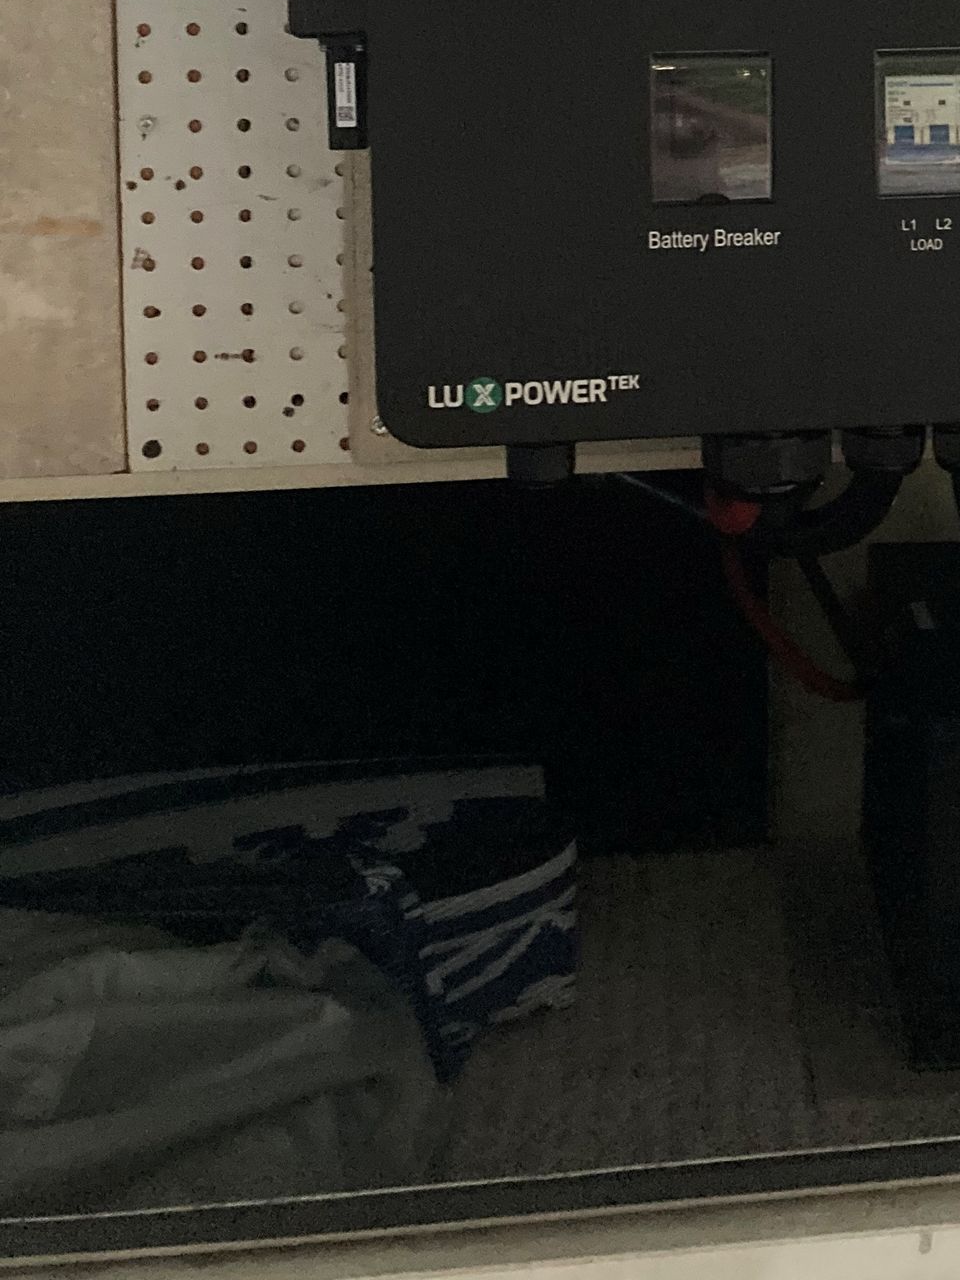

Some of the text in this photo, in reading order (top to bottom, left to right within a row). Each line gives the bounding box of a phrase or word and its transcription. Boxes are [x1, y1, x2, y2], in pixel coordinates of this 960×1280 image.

[901, 219, 917, 231] L1
[935, 218, 952, 230] L2
[648, 228, 782, 252] Battery Breaker
[910, 238, 944, 251] LOAD
